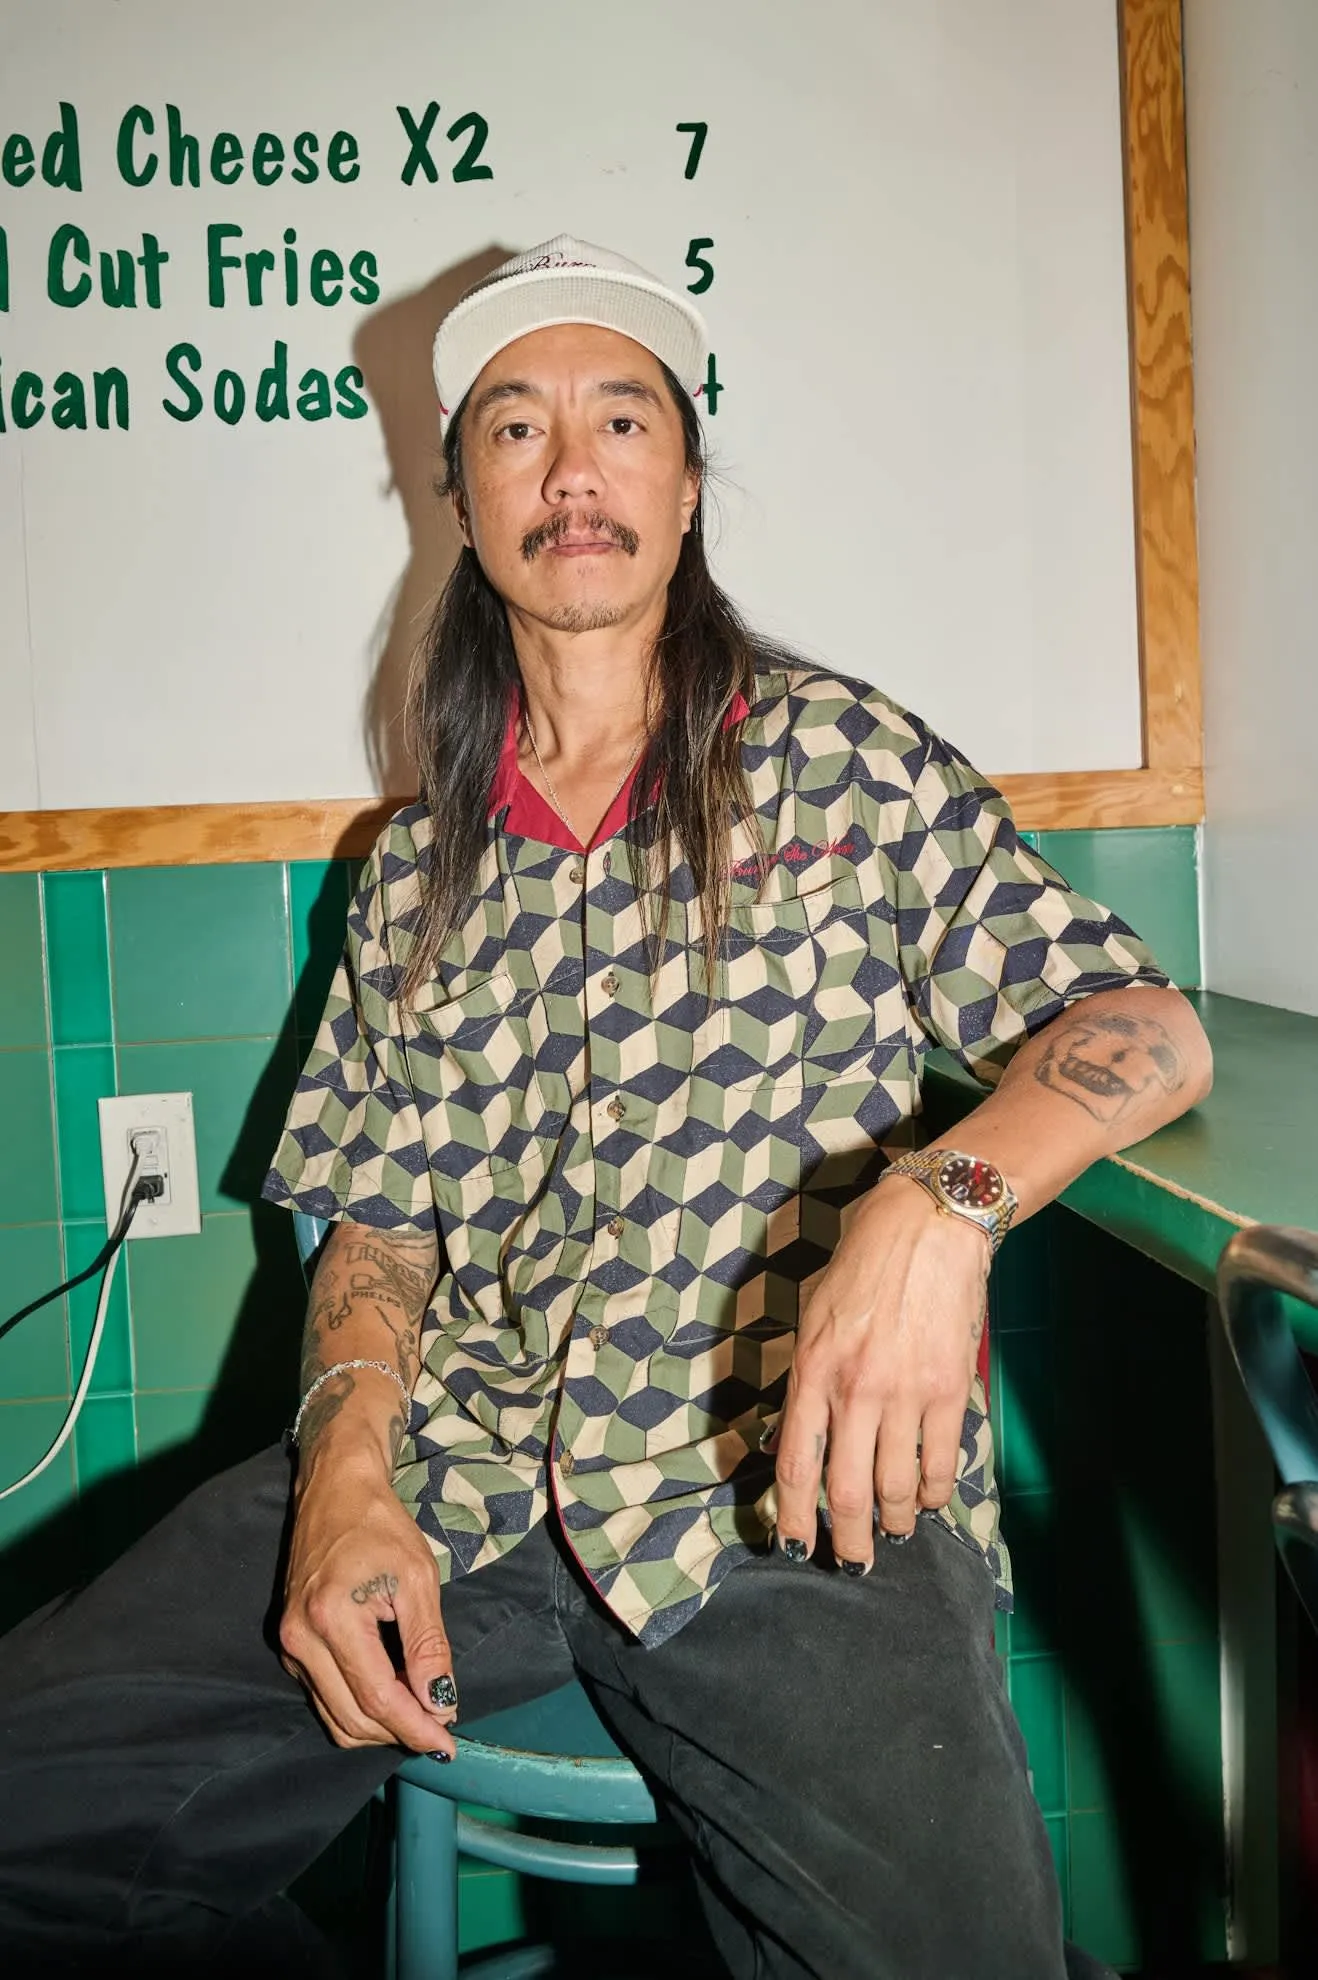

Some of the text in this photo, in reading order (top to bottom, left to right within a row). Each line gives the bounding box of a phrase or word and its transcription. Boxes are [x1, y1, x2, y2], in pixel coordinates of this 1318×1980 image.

[3, 101, 494, 192] ed Cheese X2
[675, 121, 708, 180] 7
[47, 223, 168, 309] Cut
[207, 224, 380, 308] Fries
[686, 237, 715, 294] 5
[162, 340, 368, 424] Sodas
